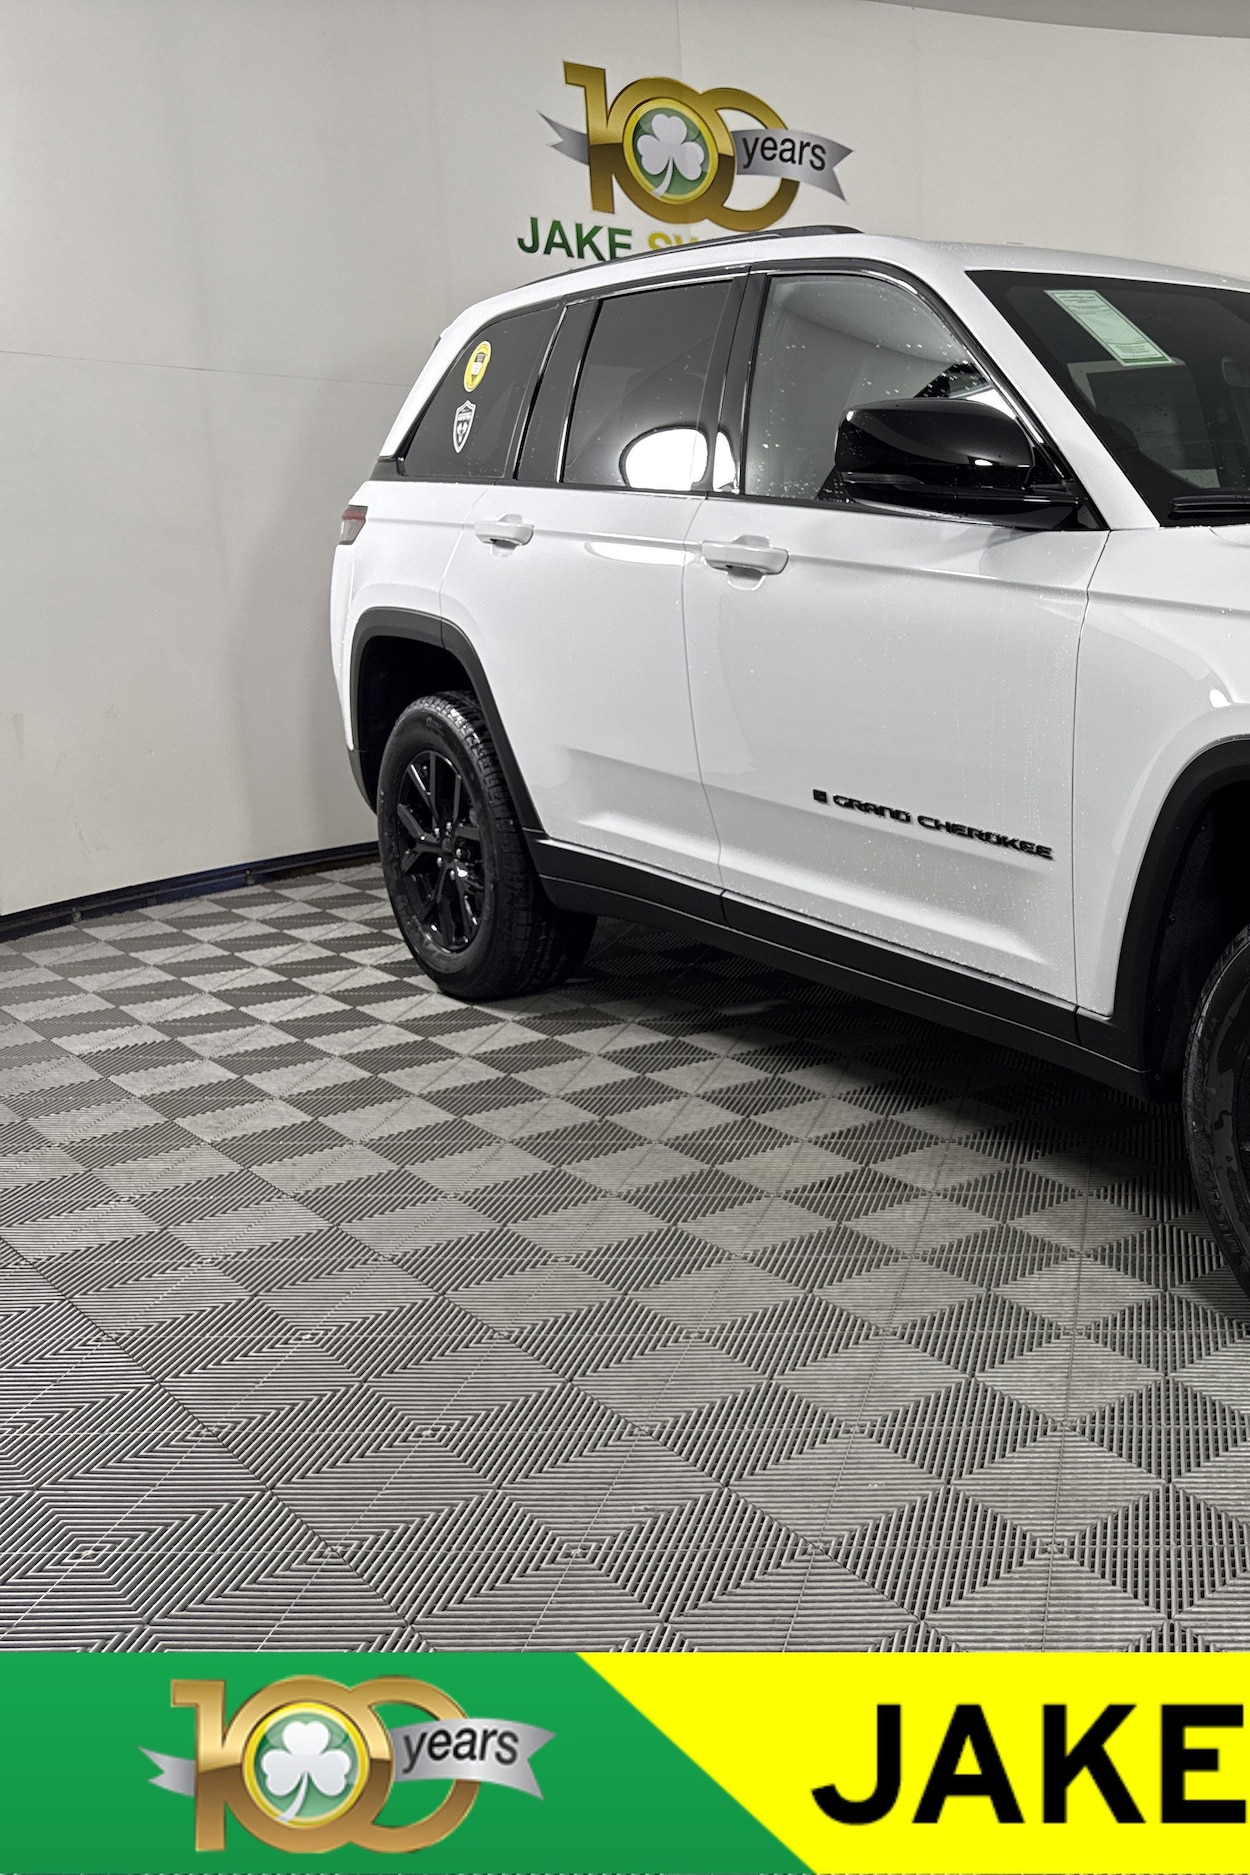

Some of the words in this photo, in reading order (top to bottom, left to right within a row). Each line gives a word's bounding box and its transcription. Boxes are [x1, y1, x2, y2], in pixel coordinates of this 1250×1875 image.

[742, 136, 827, 171] years
[517, 217, 632, 260] JAKE
[833, 795, 911, 824] GRAND
[917, 815, 1054, 860] CHEROKEE
